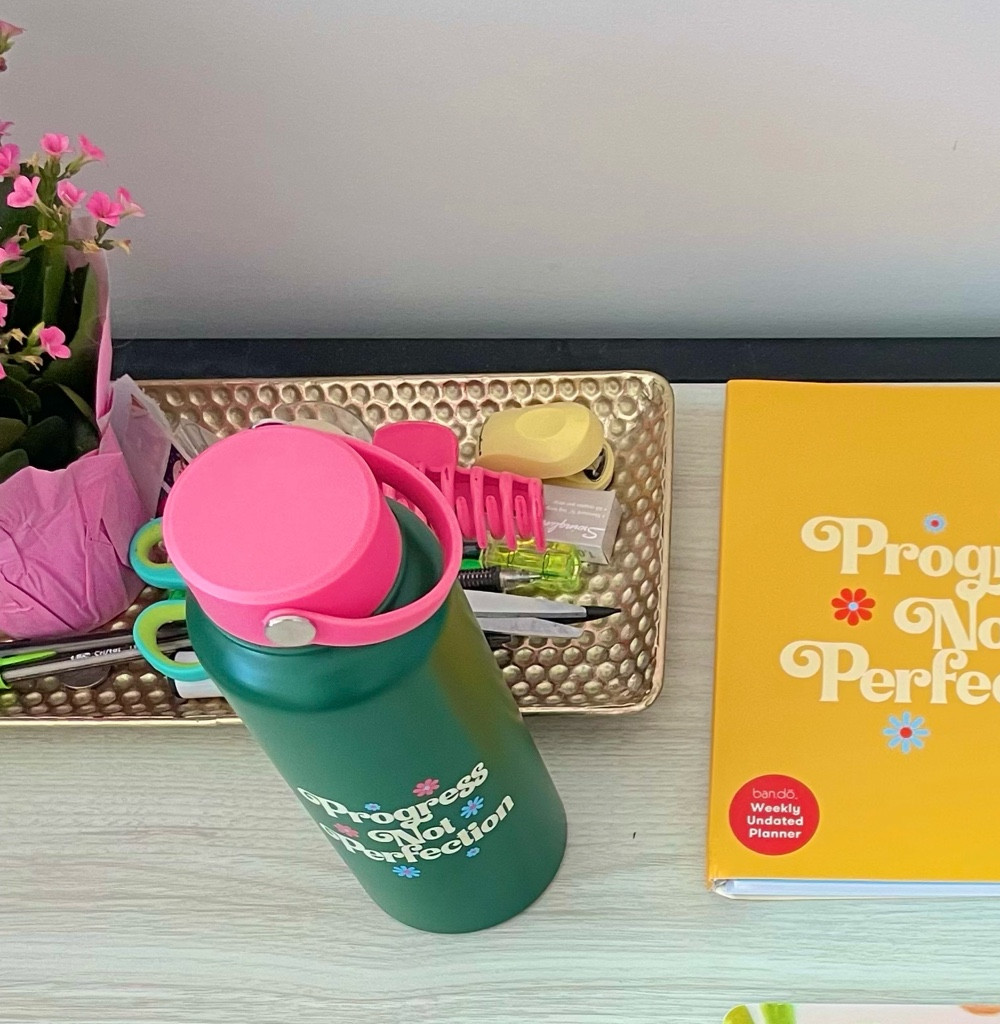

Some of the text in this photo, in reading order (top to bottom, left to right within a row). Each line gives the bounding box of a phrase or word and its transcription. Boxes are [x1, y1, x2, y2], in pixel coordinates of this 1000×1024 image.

[543, 519, 606, 539] Swinglin
[296, 761, 489, 824] Progress
[750, 802, 801, 816] Weekly
[319, 795, 515, 863] Perfection
[746, 815, 804, 826] Undated
[367, 817, 457, 846] Not
[748, 828, 802, 839] Planner
